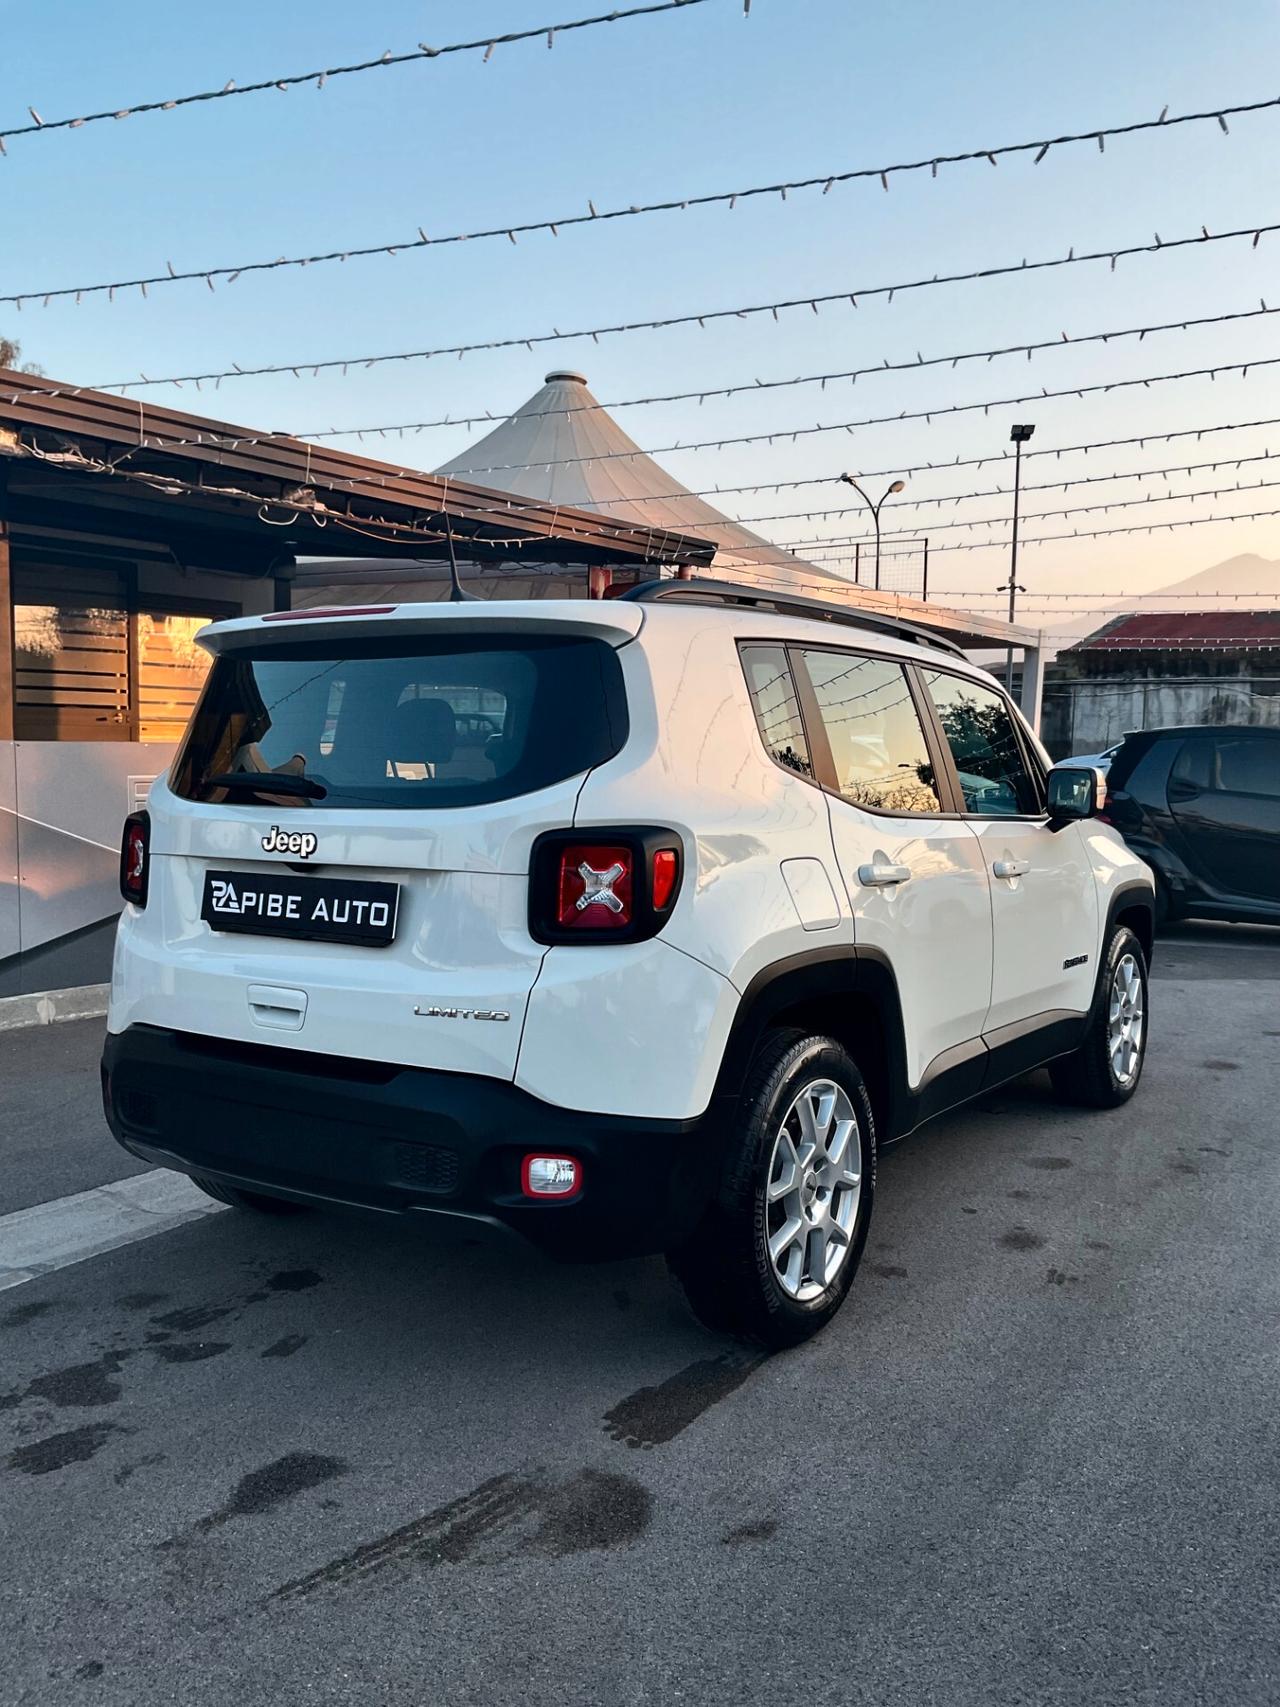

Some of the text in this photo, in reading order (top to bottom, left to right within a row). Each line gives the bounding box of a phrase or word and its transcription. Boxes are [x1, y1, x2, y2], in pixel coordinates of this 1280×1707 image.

[262, 826, 317, 858] Jeep
[241, 892, 302, 919] PIBE
[311, 898, 389, 927] AUTO
[413, 1006, 510, 1022] LIMITED
